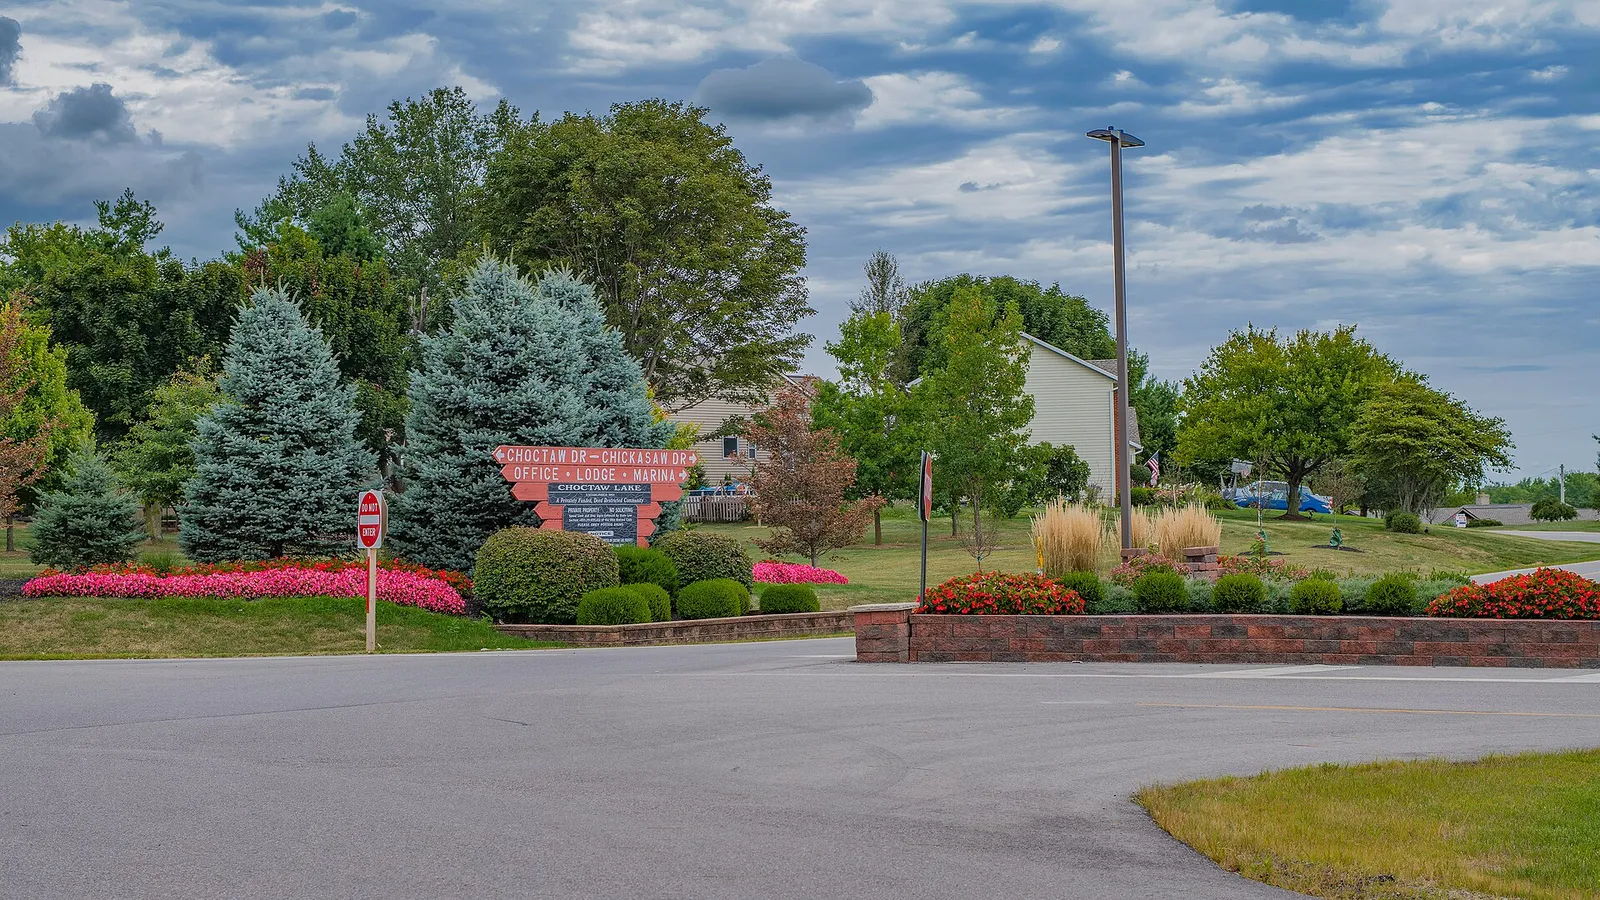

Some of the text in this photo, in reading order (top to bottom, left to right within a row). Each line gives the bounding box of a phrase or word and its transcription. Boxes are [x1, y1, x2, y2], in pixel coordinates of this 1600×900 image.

[507, 448, 566, 463] CHOCTAW
[571, 449, 586, 463] DR
[602, 451, 668, 465] CHICKASAW
[672, 452, 687, 465] DR
[514, 466, 676, 482] OFFICE LODGE MARINA
[362, 503, 378, 512] DO NOT
[363, 528, 376, 537] ENTER
